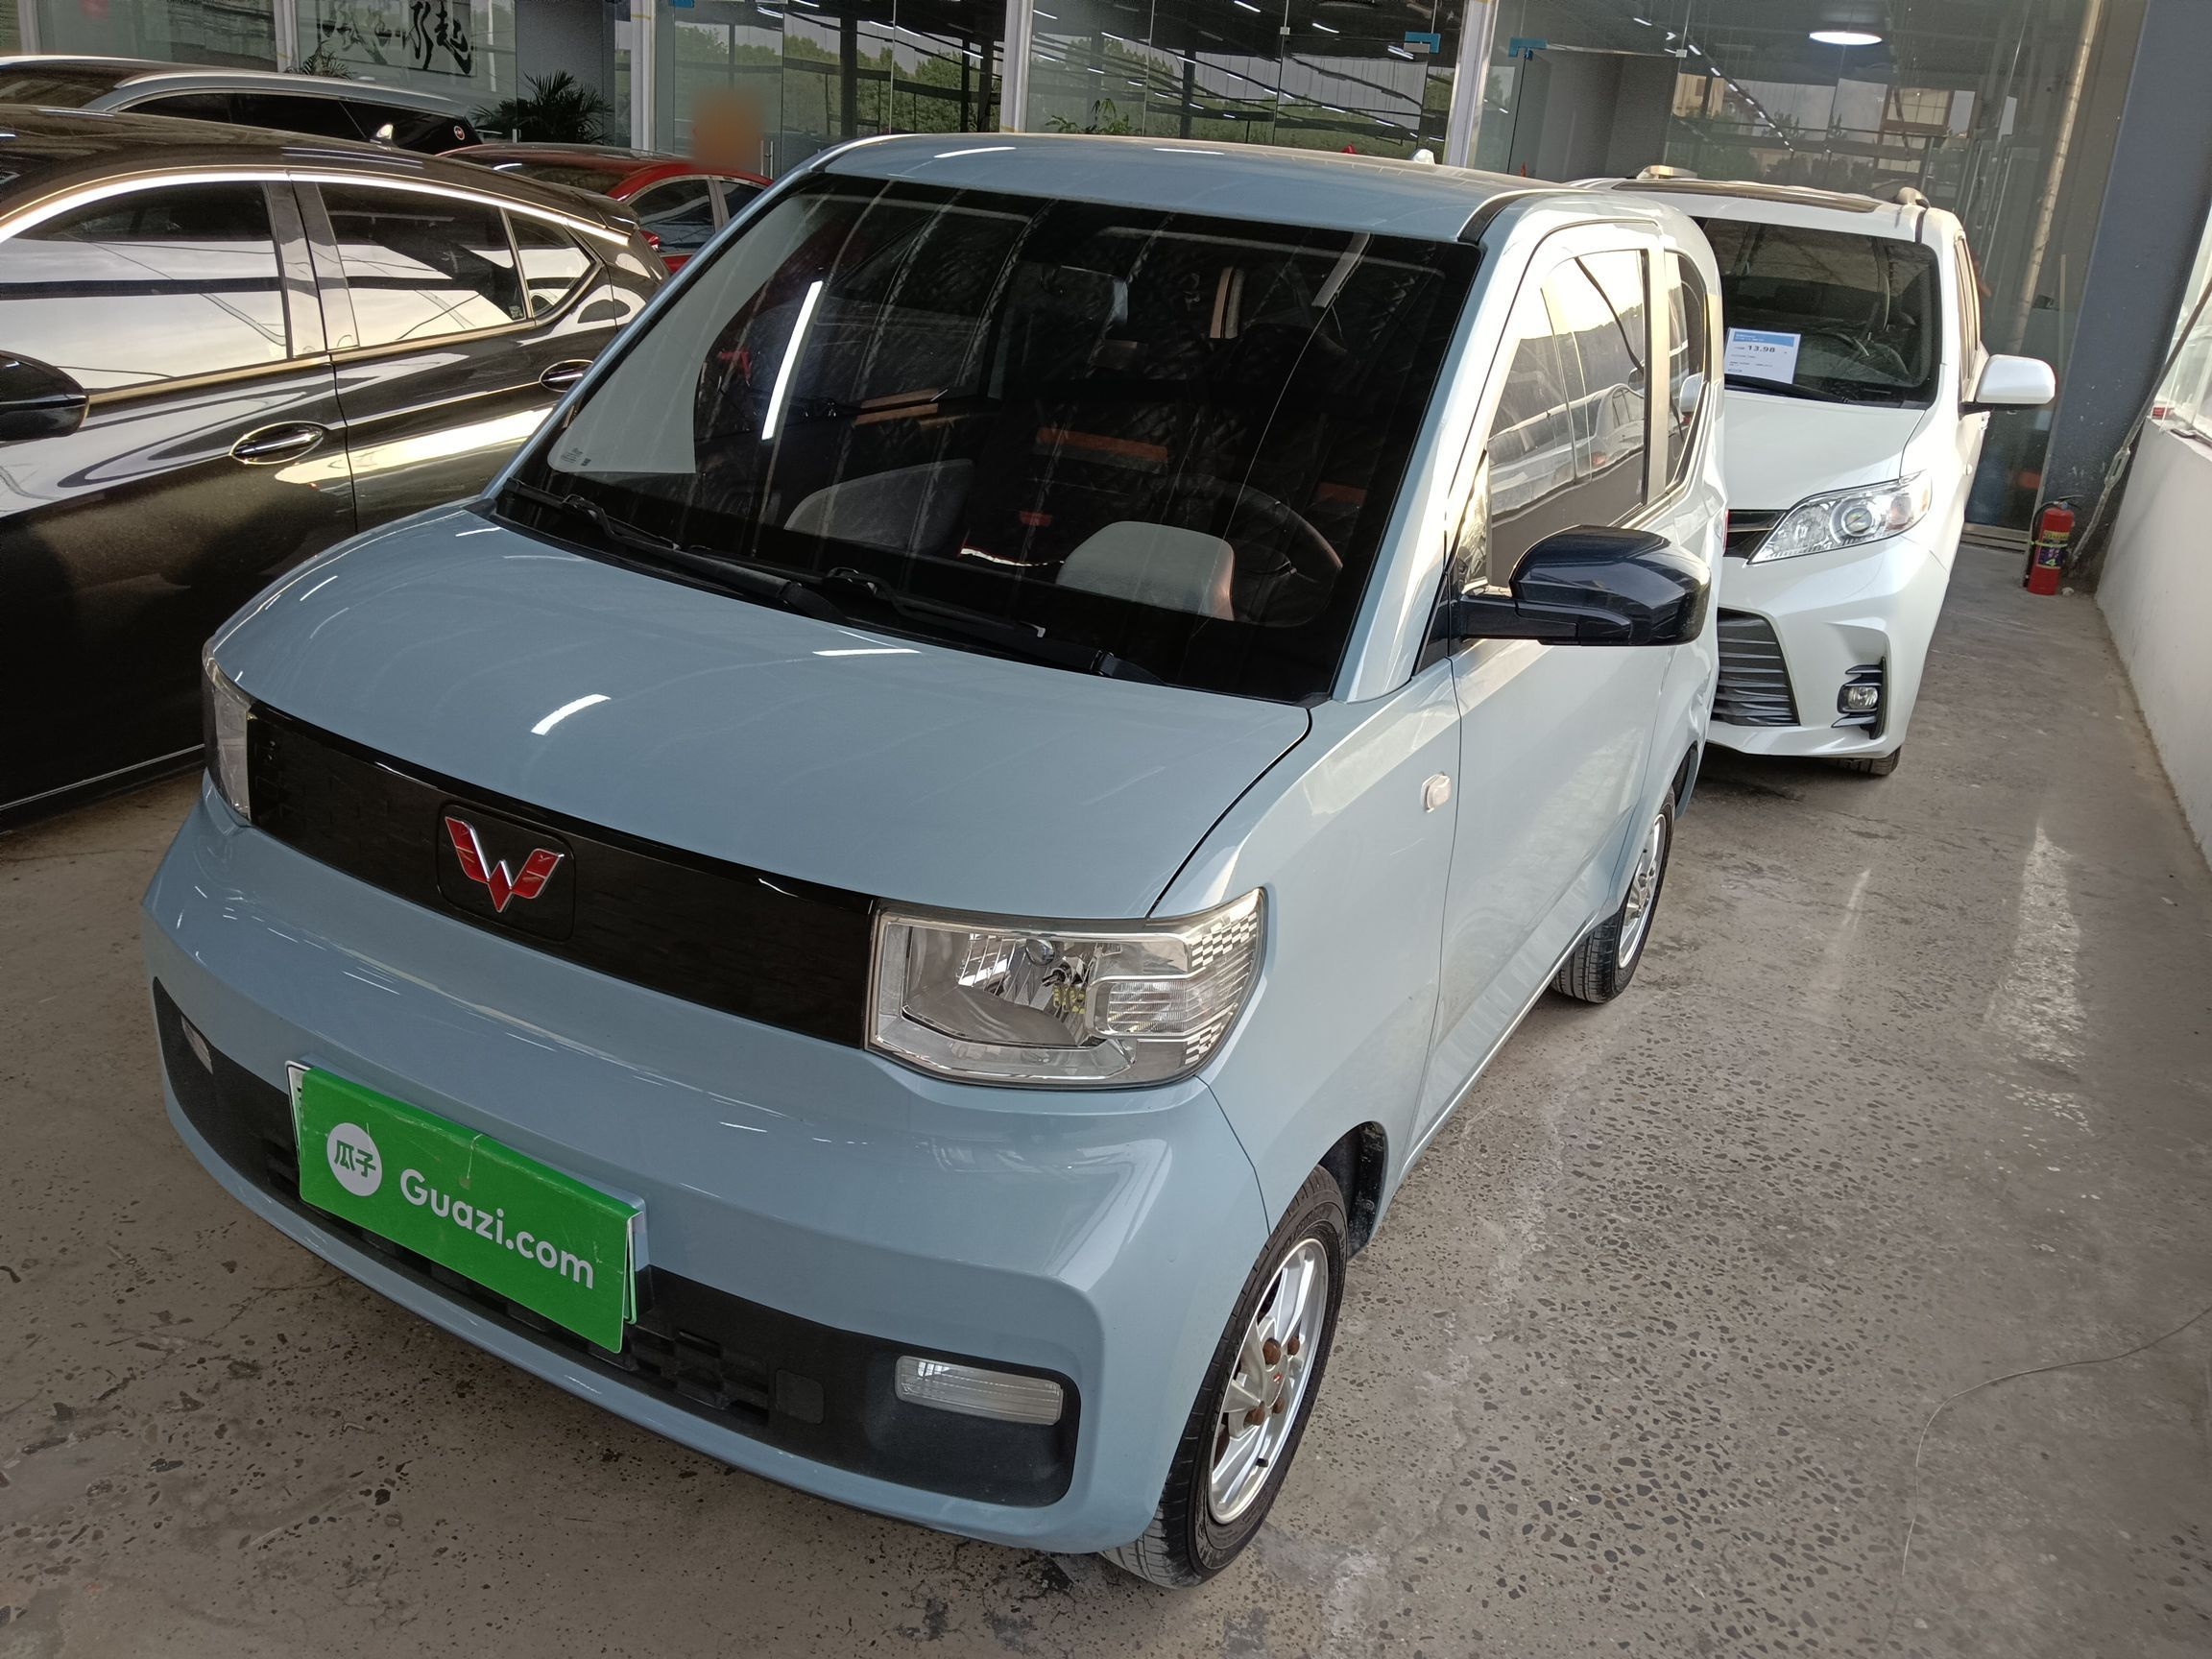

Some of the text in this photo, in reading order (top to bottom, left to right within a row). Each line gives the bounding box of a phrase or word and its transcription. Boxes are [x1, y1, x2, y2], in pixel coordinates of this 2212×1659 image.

[1747, 345, 1776, 353] 13.98
[334, 1140, 377, 1178] 瓜子
[399, 1168, 594, 1289] Guazi.com
